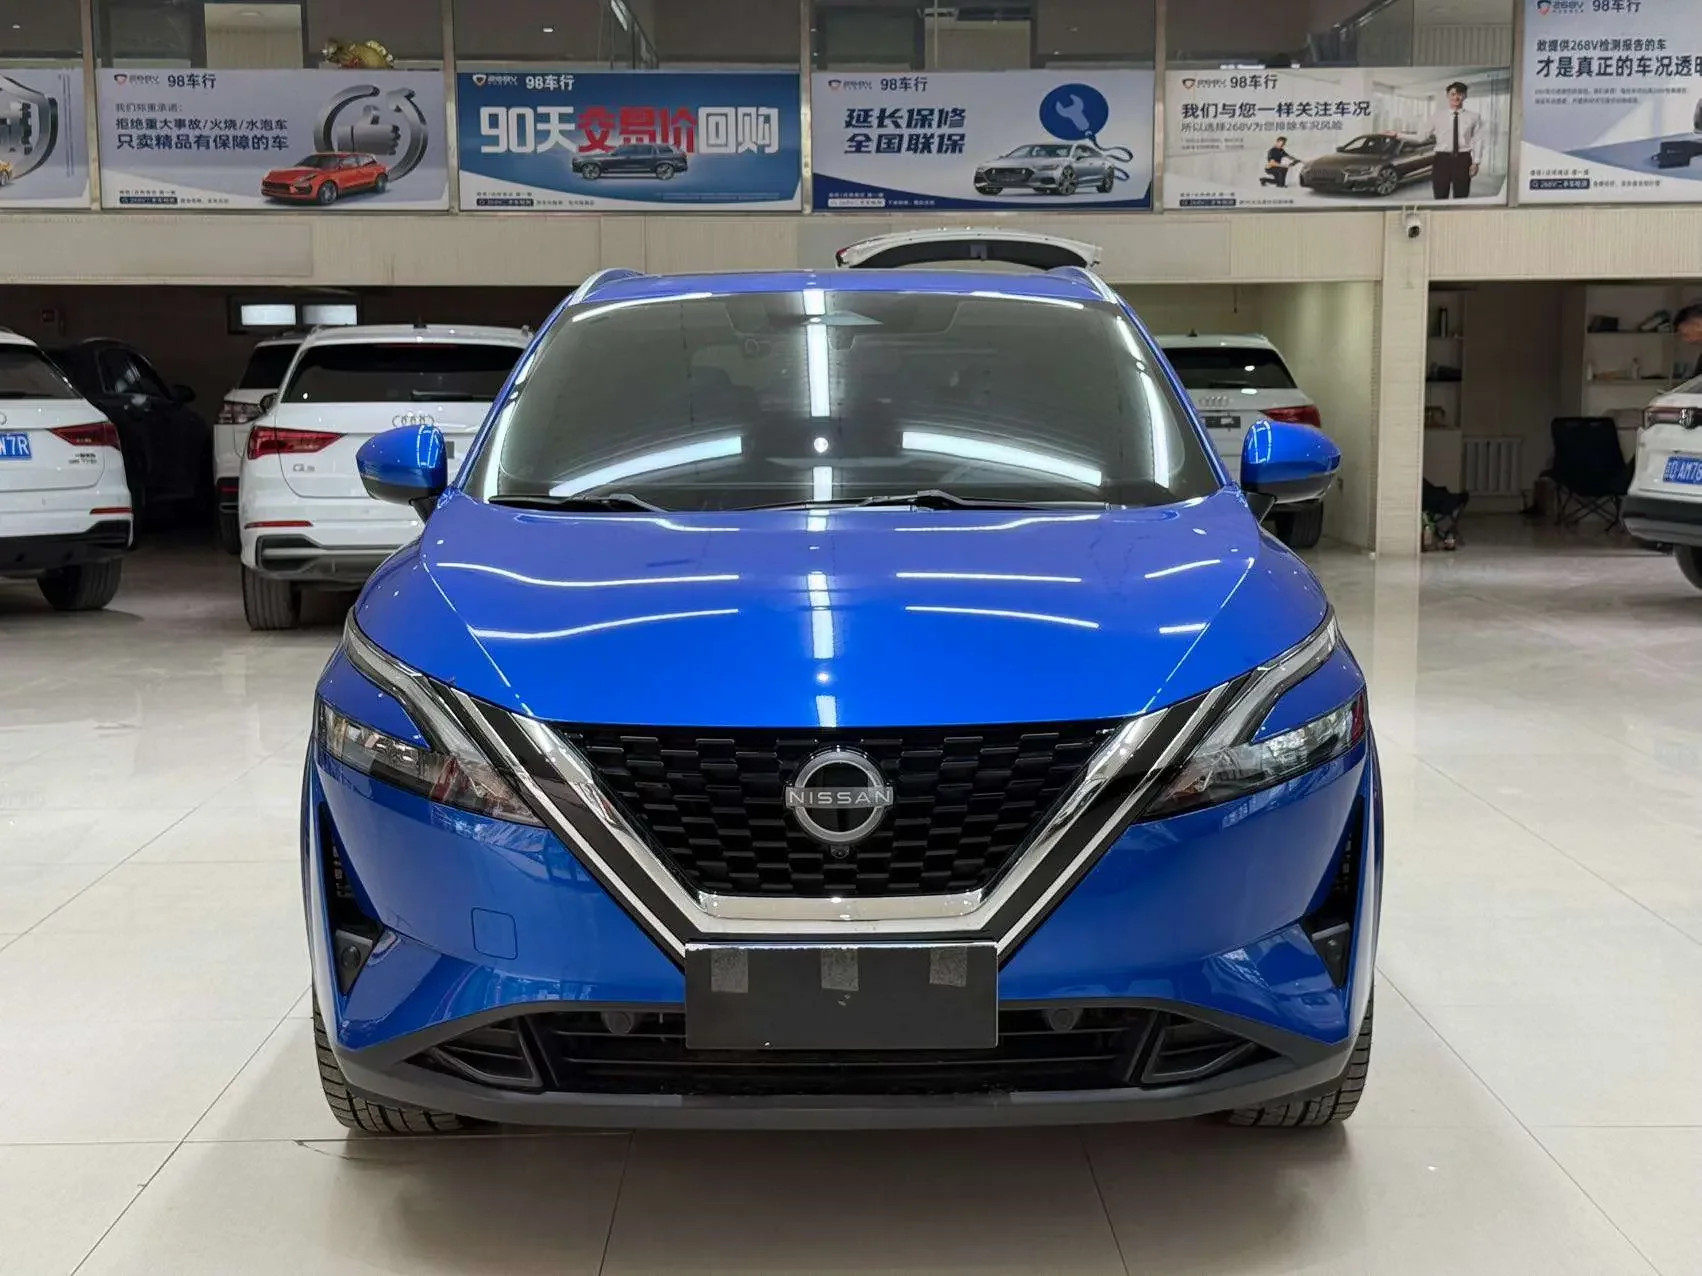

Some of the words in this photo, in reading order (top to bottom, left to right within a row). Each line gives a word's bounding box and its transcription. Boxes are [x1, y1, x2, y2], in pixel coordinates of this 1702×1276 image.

[1592, 0, 1642, 13] 98车行
[1536, 39, 1667, 52] 敢提供268V检测报告的车
[167, 73, 217, 90] 98车行
[525, 74, 575, 91] 98车行
[880, 76, 928, 92] 98车行
[1229, 74, 1279, 91] 98车行
[1181, 100, 1372, 118] 我们与您一样关注车况
[115, 117, 288, 131] 拒绝重大事故/火烧/水泡车
[844, 107, 967, 129] 延长保修
[1180, 119, 1344, 133] 所以选择268V为您排除车况风险
[116, 134, 290, 151] 只卖精品有保障的车
[843, 133, 967, 154] 全国联保
[789, 791, 890, 804] NISSAN
